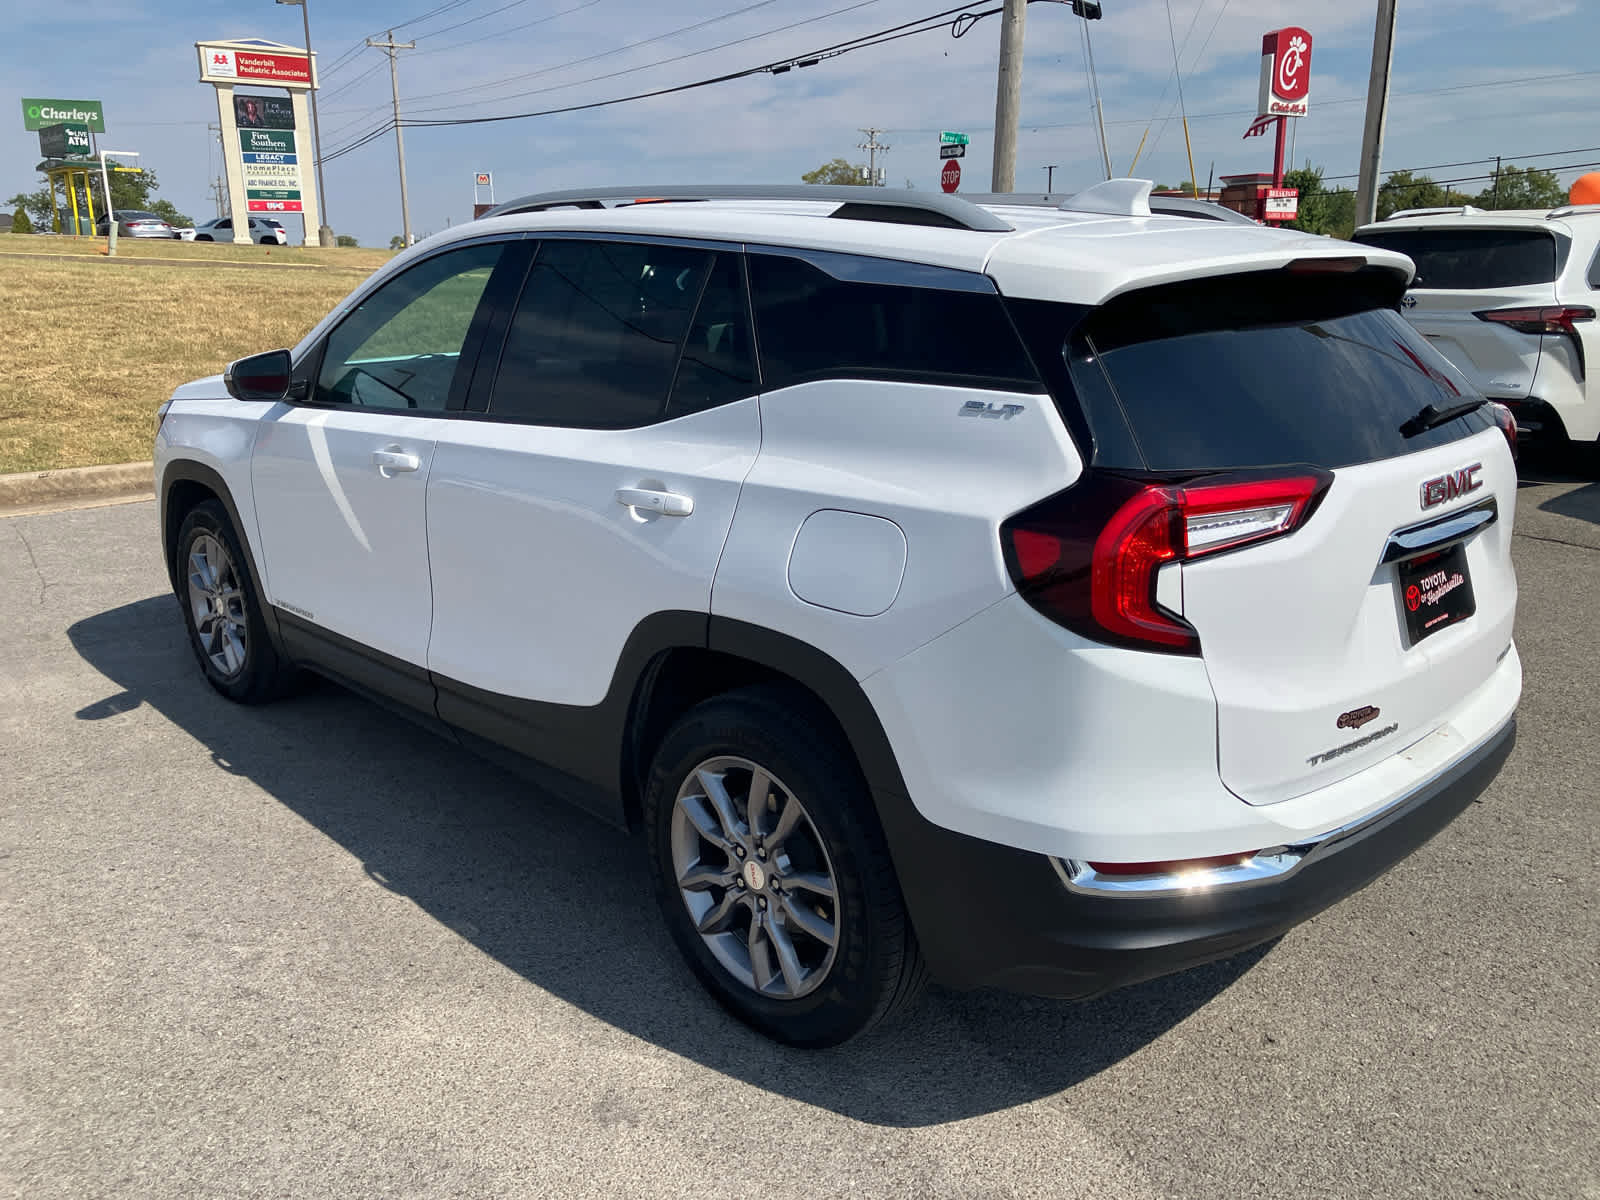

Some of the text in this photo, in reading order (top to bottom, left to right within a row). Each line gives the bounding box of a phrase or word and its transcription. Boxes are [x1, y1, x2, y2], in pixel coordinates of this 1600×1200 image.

[239, 58, 275, 66] Vanderbilt
[240, 65, 270, 75] Pediatric
[271, 68, 309, 77] Associates
[28, 105, 98, 123] O'Charleys
[68, 137, 89, 146] ATM
[252, 131, 270, 141] First
[251, 138, 286, 148] Southern
[247, 179, 258, 187] ABC
[258, 179, 277, 187] FINANCE
[942, 170, 960, 184] STOP
[958, 400, 1025, 420] SLT
[1420, 462, 1483, 511] GMC
[1420, 571, 1447, 592] TOYOTA
[1305, 721, 1399, 767] TERRAIN
